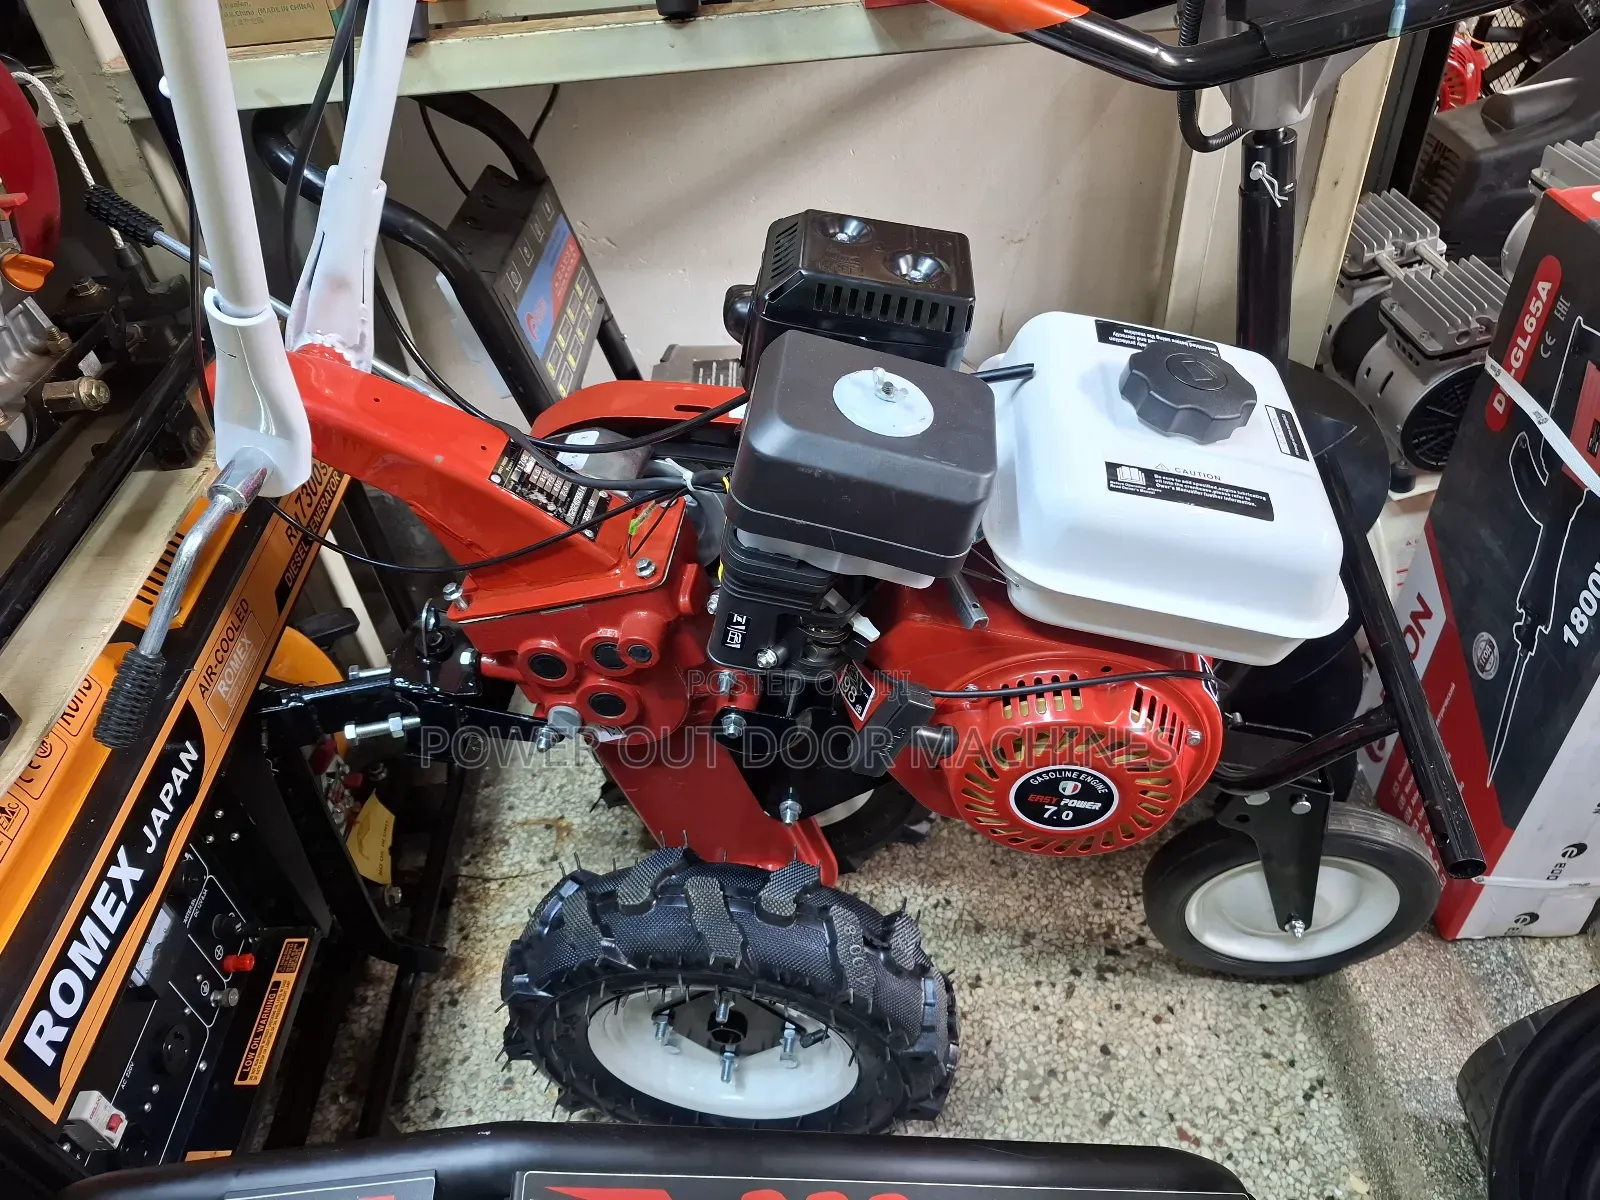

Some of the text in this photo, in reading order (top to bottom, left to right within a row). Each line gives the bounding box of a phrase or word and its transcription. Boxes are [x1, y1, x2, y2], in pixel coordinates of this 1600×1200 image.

[1175, 467, 1223, 481] CAUTION
[284, 470, 341, 587] DIESEL ENERATOR
[1563, 561, 1600, 647] 1800
[198, 598, 250, 700] AIR-COOLED
[217, 632, 252, 699] ROMEX
[842, 675, 857, 703] 98
[1028, 793, 1102, 810] EASY POWER
[1030, 770, 1108, 794] GASOLINE ENGINE
[1043, 805, 1073, 820] 7.0
[24, 740, 200, 1067] ROMEX JAPAN
[241, 1051, 255, 1072] LOW
[249, 1033, 261, 1050] OIL
[255, 992, 276, 1033] WARNING
[121, 1080, 128, 1090] AC
